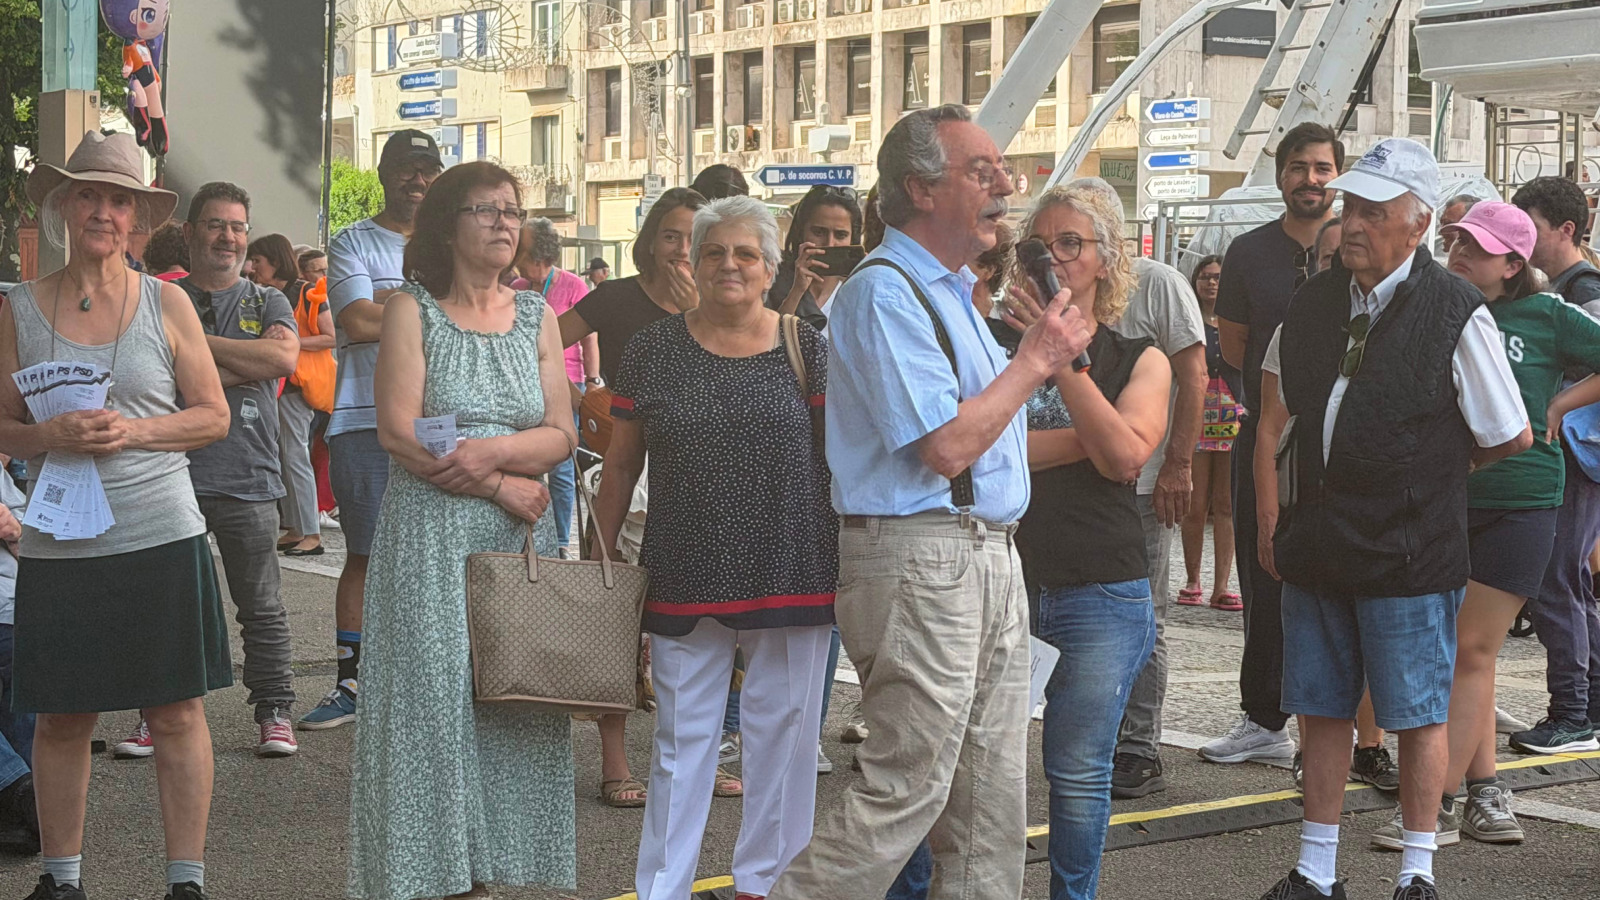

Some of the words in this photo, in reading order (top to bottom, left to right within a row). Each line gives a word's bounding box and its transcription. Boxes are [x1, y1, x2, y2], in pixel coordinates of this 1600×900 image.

[1178, 131, 1197, 140] Palmeira
[780, 173, 787, 181] p.
[788, 171, 797, 180] de
[798, 172, 827, 180] socorros
[828, 170, 836, 180] C.
[837, 170, 845, 179] V.
[846, 169, 853, 179] P.
[57, 366, 71, 376] PS
[73, 366, 94, 377] PSD
